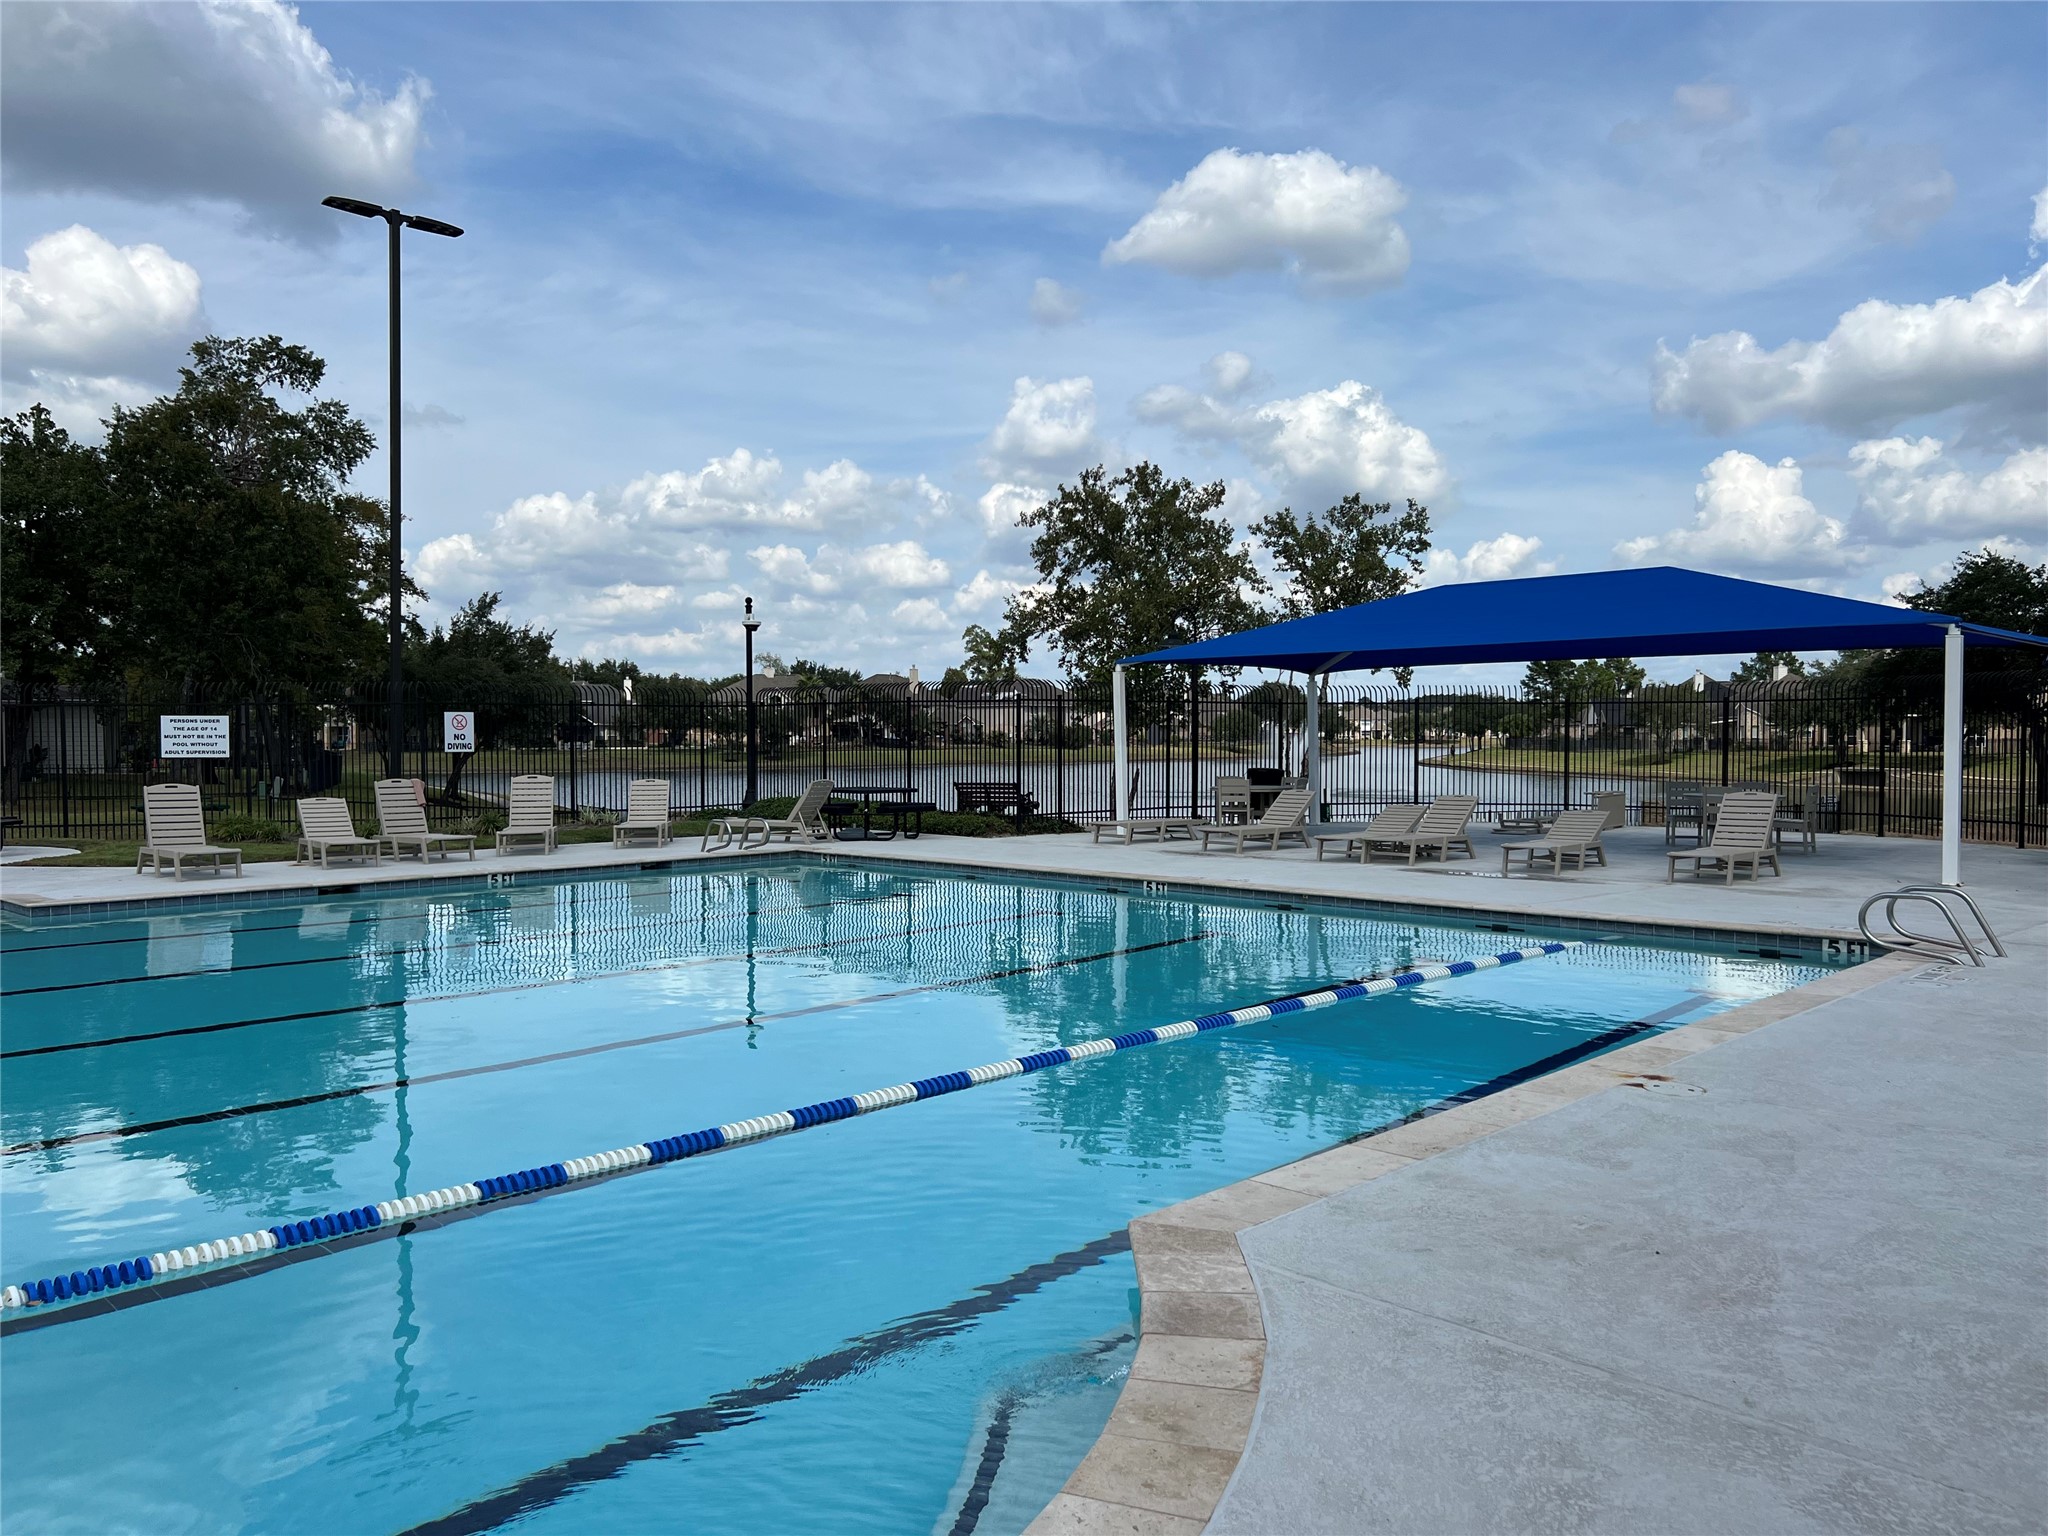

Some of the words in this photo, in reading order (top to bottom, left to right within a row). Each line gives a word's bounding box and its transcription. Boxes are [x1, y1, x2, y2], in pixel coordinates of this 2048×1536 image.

[453, 733, 466, 741] NO
[502, 873, 513, 882] FT
[1156, 882, 1167, 891] FT
[1827, 939, 1841, 953] 5
[1847, 941, 1868, 955] FT
